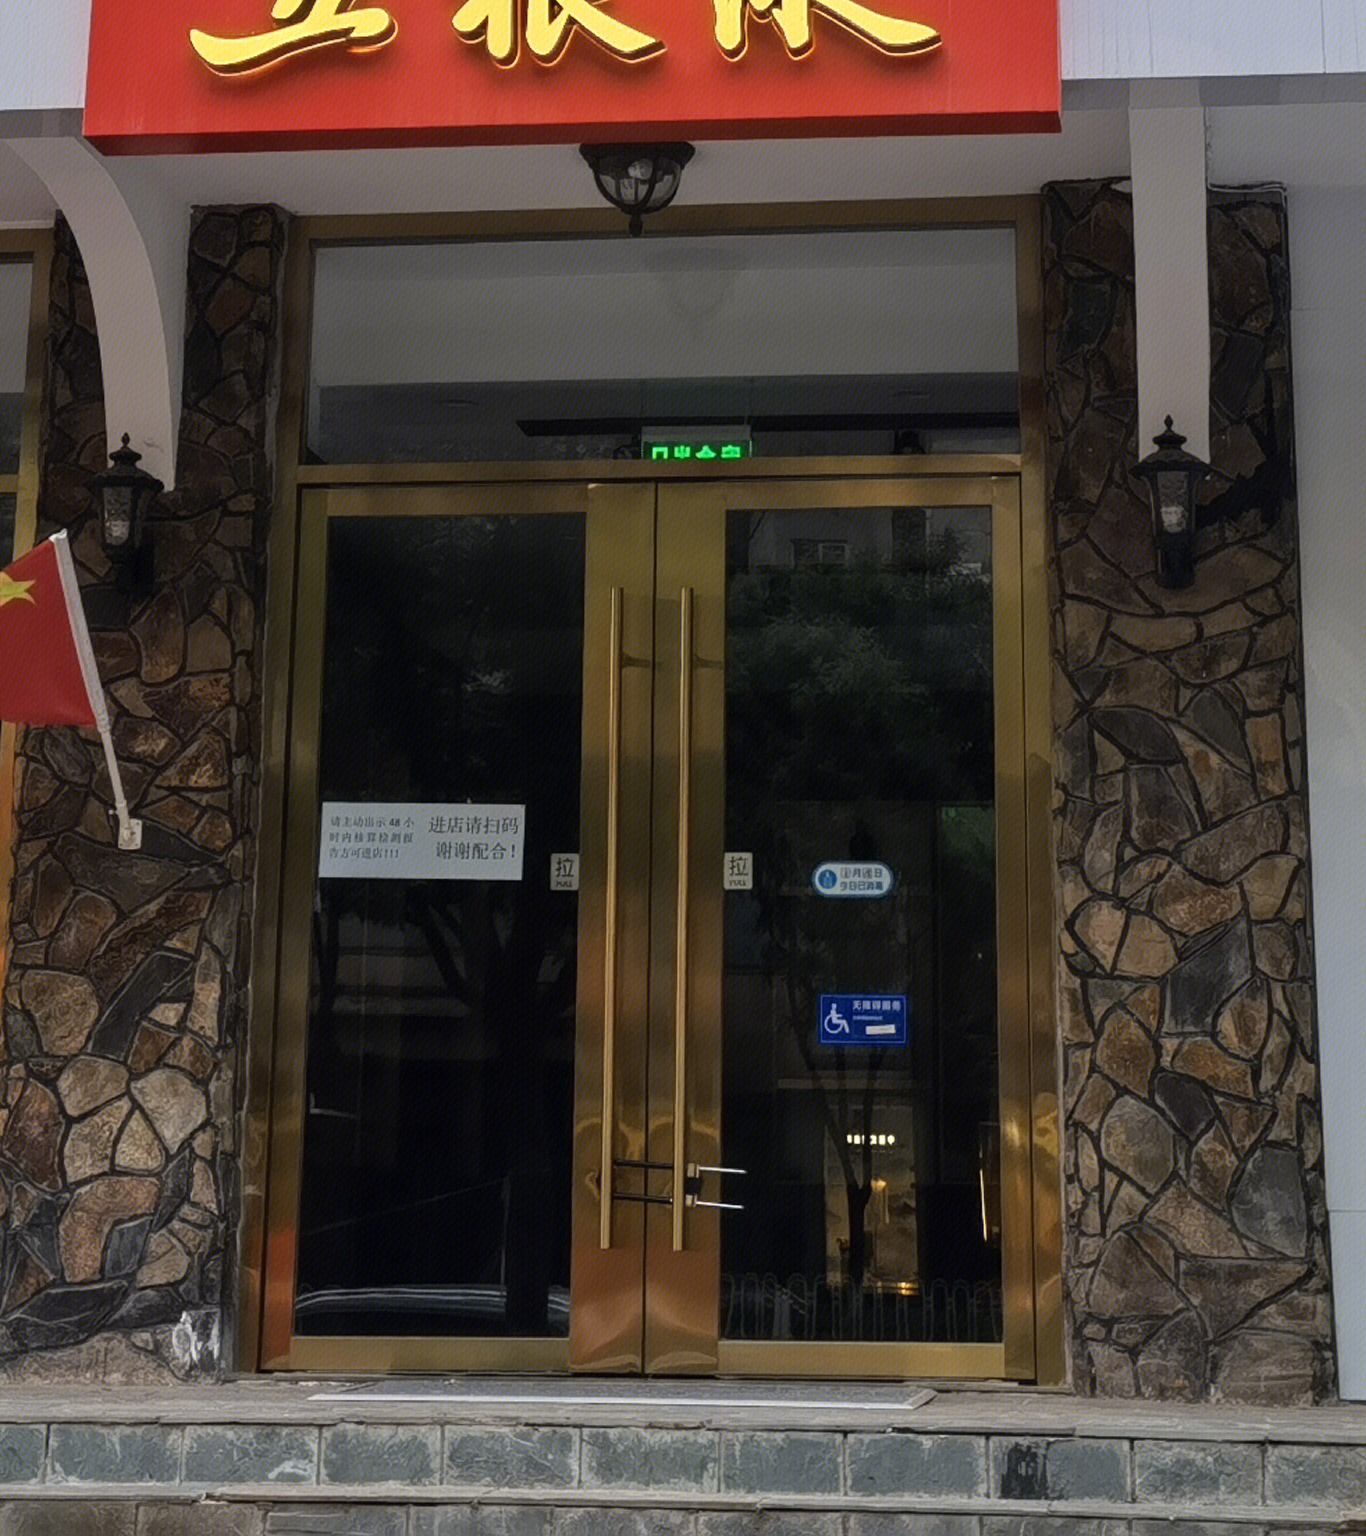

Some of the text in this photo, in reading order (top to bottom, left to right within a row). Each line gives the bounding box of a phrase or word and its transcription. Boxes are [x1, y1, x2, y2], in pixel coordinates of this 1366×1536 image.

[428, 815, 519, 836] 进店请扫码
[555, 857, 575, 878] 拉
[728, 855, 749, 876] 拉
